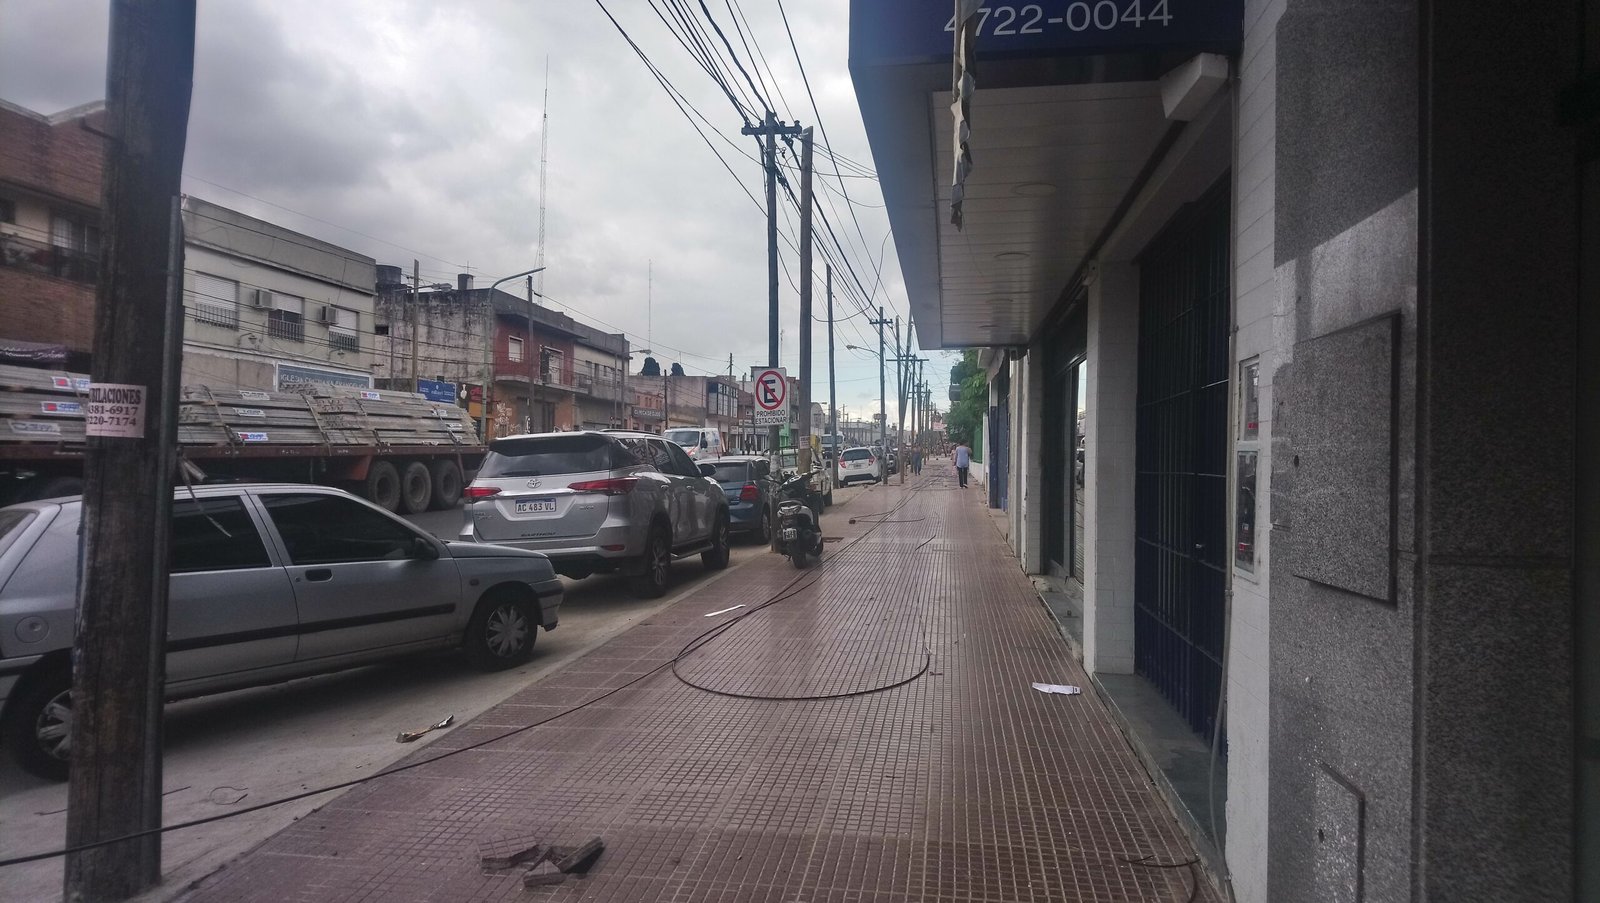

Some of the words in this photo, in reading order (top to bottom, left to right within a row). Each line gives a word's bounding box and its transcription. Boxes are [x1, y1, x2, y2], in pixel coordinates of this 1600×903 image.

[89, 387, 141, 405] BILACIONES
[756, 409, 786, 417] PROHIBIDO
[755, 416, 787, 425] ESTACIONAR
[517, 504, 527, 512] AC
[529, 503, 542, 511] 483
[545, 502, 554, 510] VL
